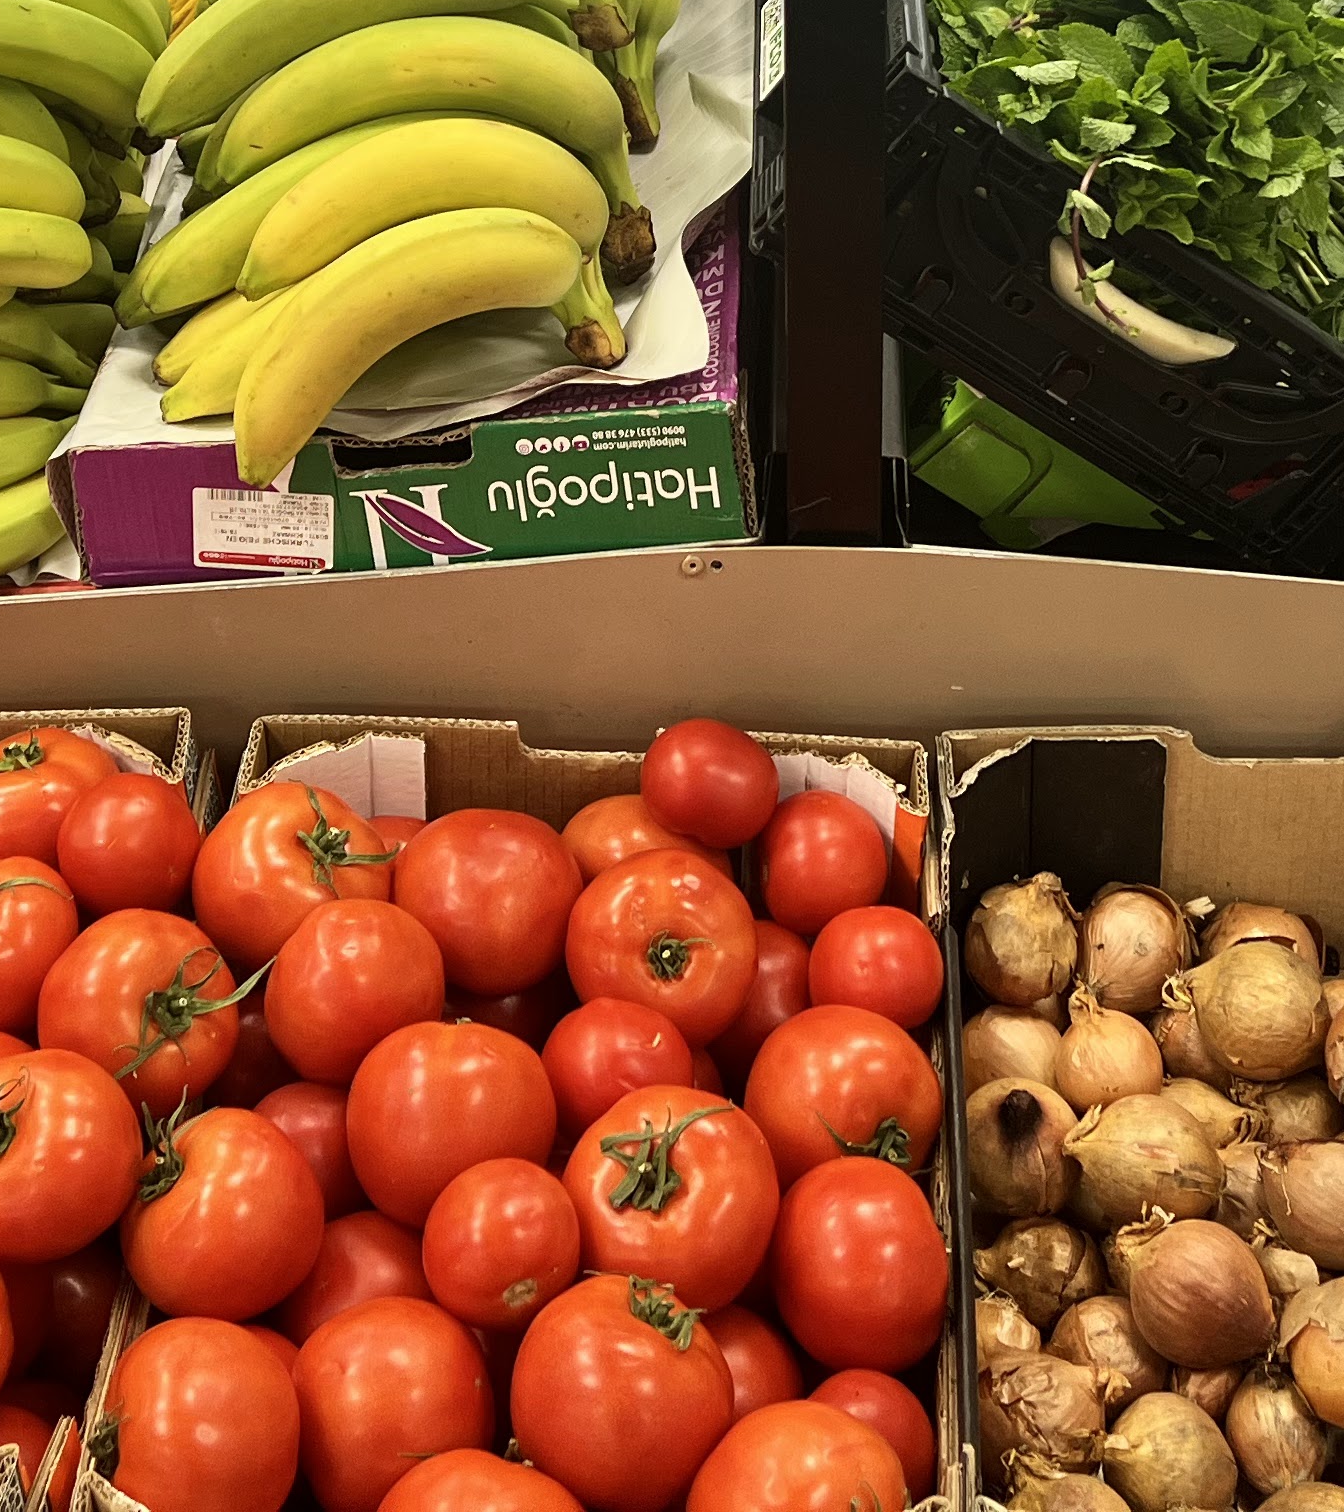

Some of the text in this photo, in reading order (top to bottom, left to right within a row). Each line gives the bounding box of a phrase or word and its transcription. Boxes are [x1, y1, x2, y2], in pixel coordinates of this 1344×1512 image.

[769, 25, 784, 68] IFCO
[702, 318, 721, 378] COLOGNE
[592, 426, 685, 441] 0090 (533) 476 38 80
[592, 437, 687, 451] hatipoglutarim.com
[487, 460, 721, 522] Hatipoğlu
